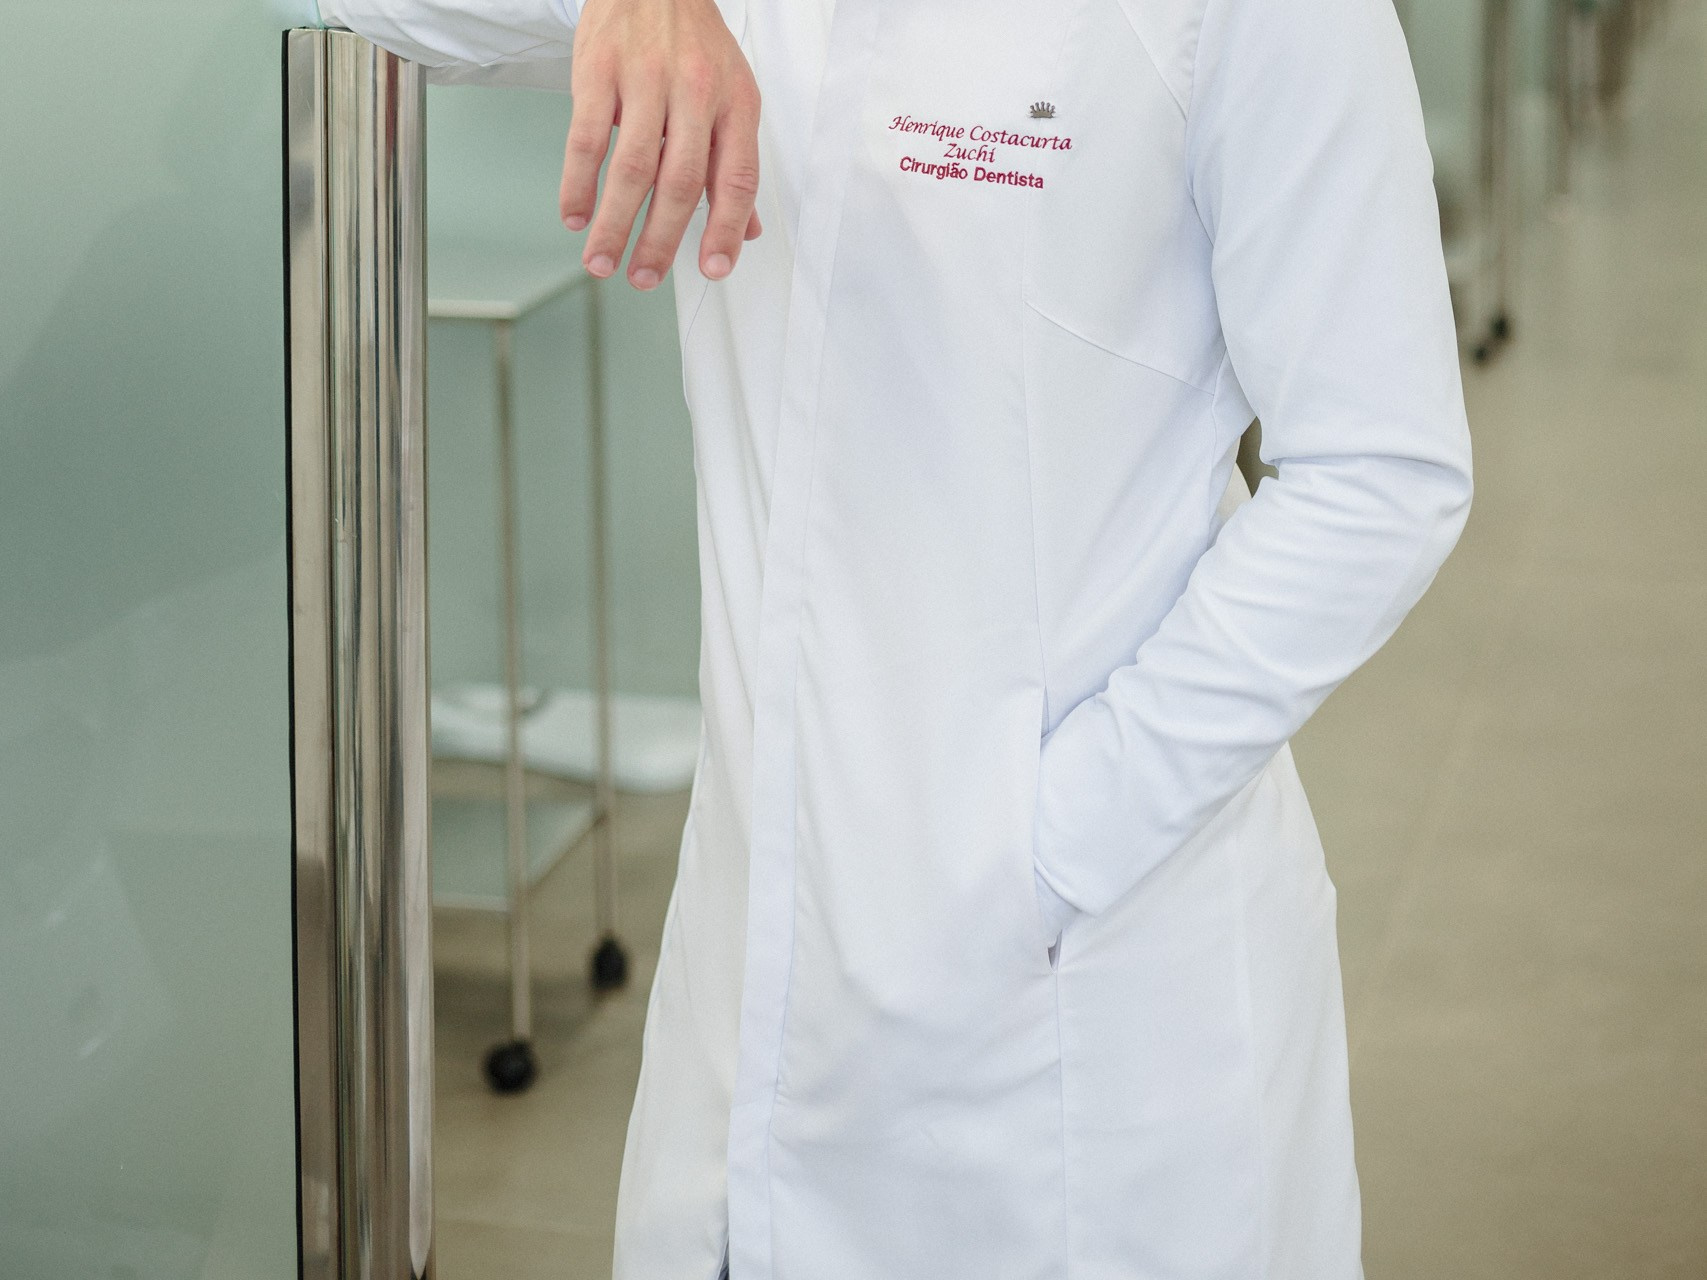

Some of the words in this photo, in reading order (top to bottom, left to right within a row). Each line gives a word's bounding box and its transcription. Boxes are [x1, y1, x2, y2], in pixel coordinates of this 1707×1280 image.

[888, 116, 965, 141] Henrique
[969, 125, 1072, 150] Costacurta
[943, 143, 996, 163] Zuchi
[899, 156, 968, 180] Cirurgião
[973, 166, 1044, 189] Dentista
